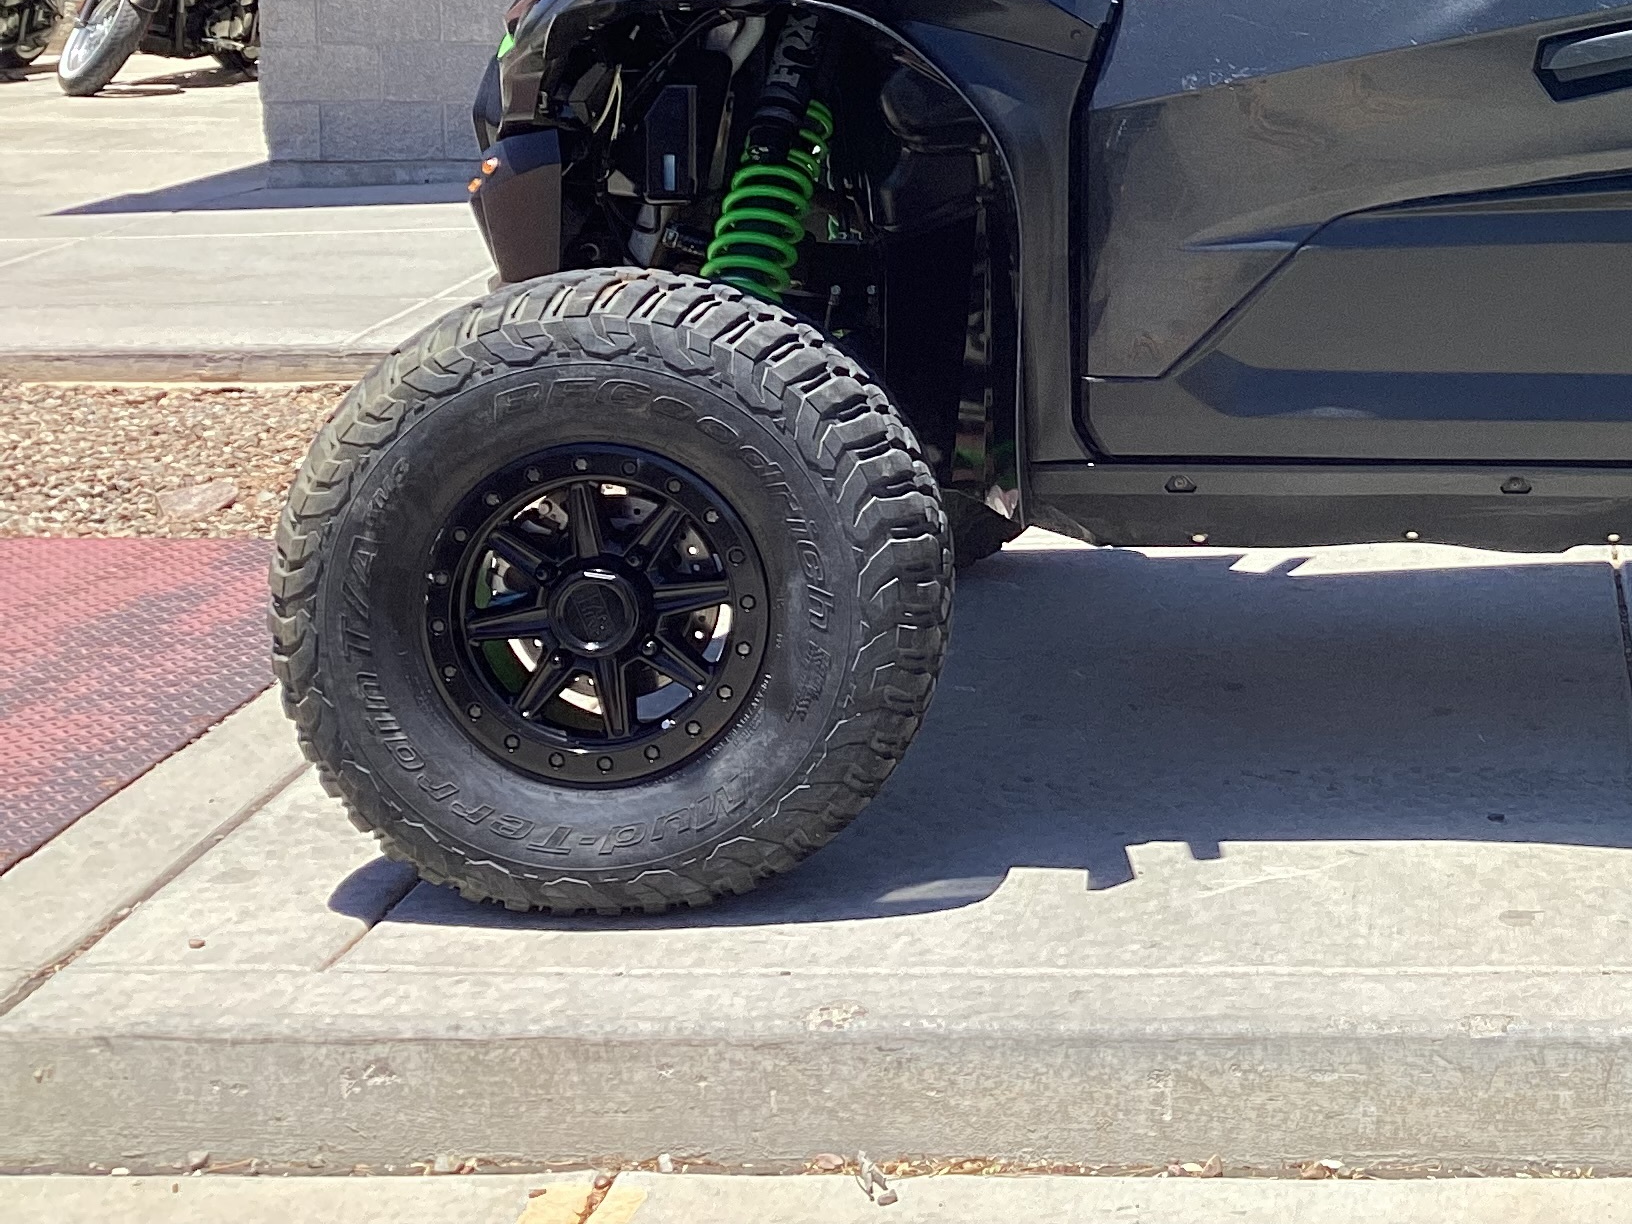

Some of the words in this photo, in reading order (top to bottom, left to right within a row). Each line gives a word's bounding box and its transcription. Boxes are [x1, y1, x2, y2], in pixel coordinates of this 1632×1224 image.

[494, 377, 835, 630] BFGoodrich
[338, 534, 377, 662] T/A
[357, 671, 750, 855] Mud-Terrain
